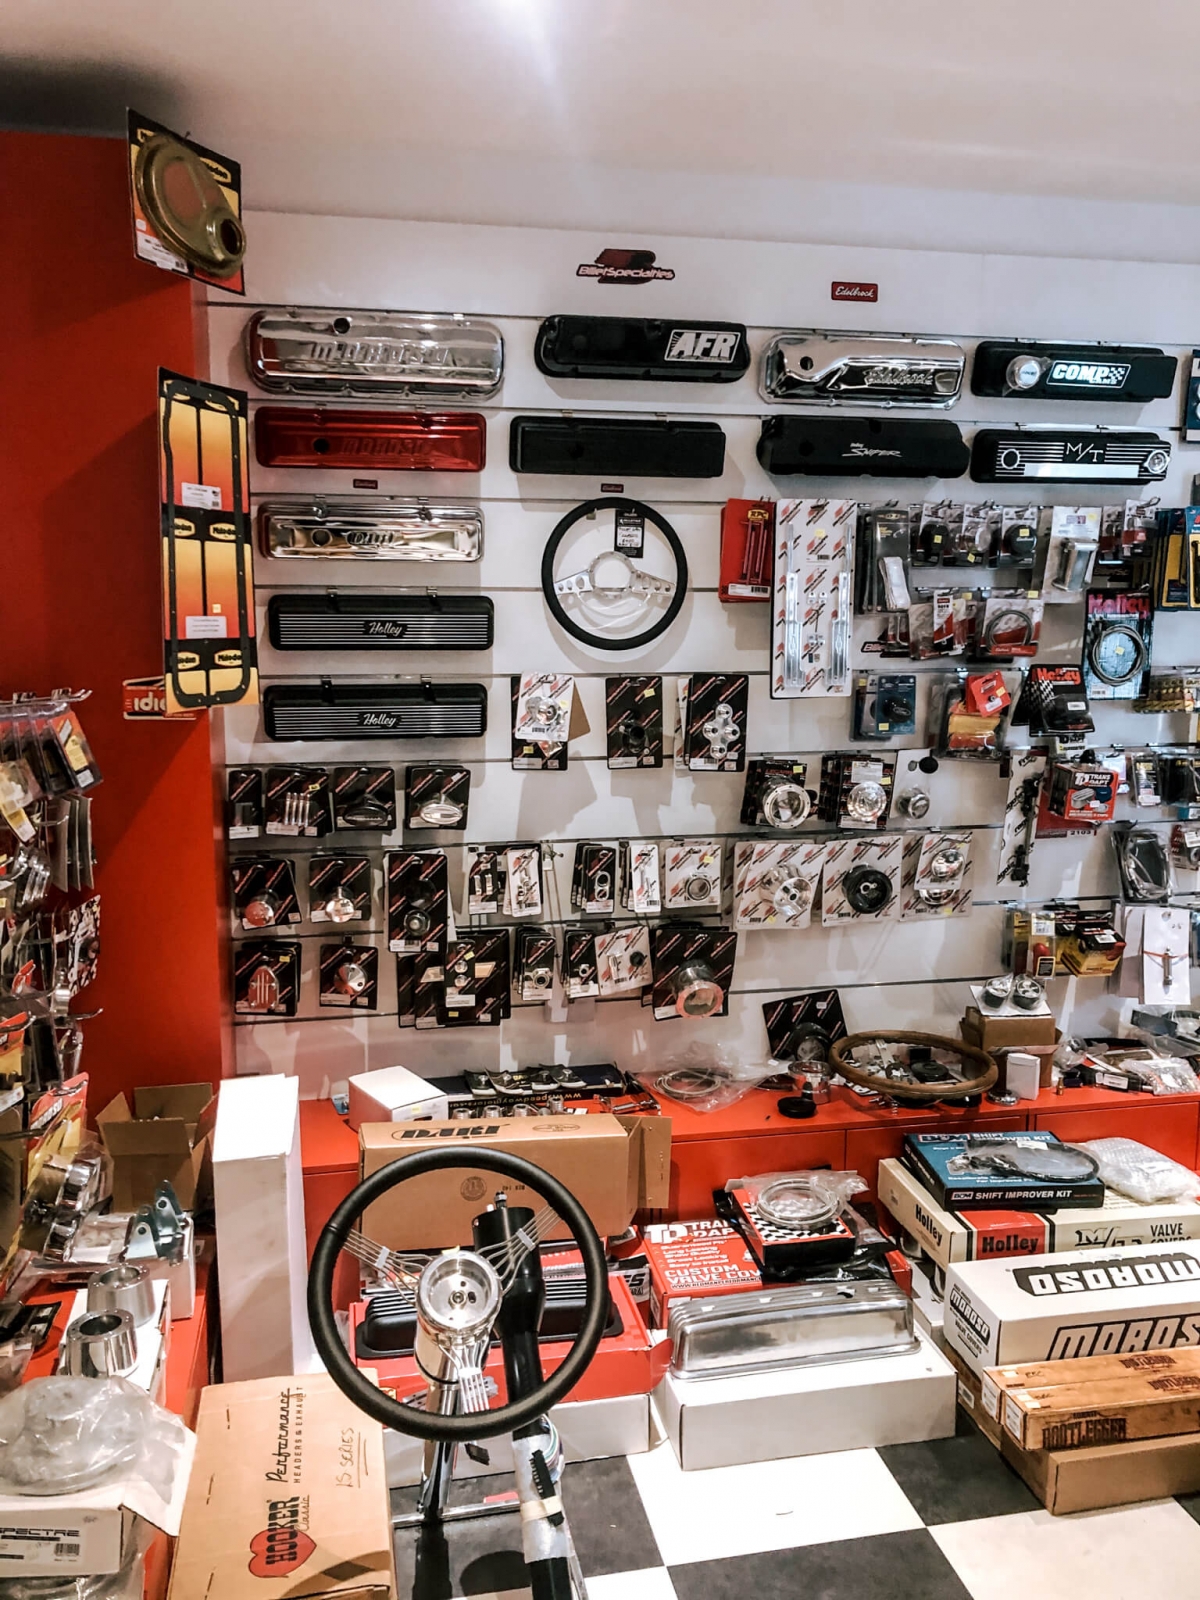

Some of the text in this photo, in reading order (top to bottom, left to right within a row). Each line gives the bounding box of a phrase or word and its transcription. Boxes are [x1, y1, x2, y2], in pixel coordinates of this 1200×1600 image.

[835, 285, 875, 298] Edelbrock
[669, 332, 736, 358] AFR
[1052, 364, 1110, 381] COMP
[1066, 442, 1104, 462] M/T
[1088, 593, 1150, 619] Holley
[368, 621, 403, 637] Holley
[363, 713, 397, 728] Holley
[975, 1191, 1003, 1200] SHIFT
[1005, 1190, 1054, 1199] IMPROVER
[1056, 1190, 1073, 1198] KIT
[693, 1227, 736, 1238] DAP
[915, 1203, 943, 1247] Holley
[1150, 1222, 1184, 1237] VALVE
[982, 1233, 1039, 1254] Holley
[664, 1264, 740, 1278] CUSTOM
[666, 1269, 761, 1285] VALVE COV
[1028, 1258, 1200, 1296] MOROSO
[950, 1289, 990, 1339] MOROSO
[1050, 1315, 1200, 1359] MOROS
[295, 1386, 305, 1427] EXHAUST
[336, 1427, 355, 1467] SERIES
[293, 1436, 303, 1484] HEADERS
[265, 1387, 300, 1566] HOOKER Performance
[295, 1494, 310, 1533] Classic
